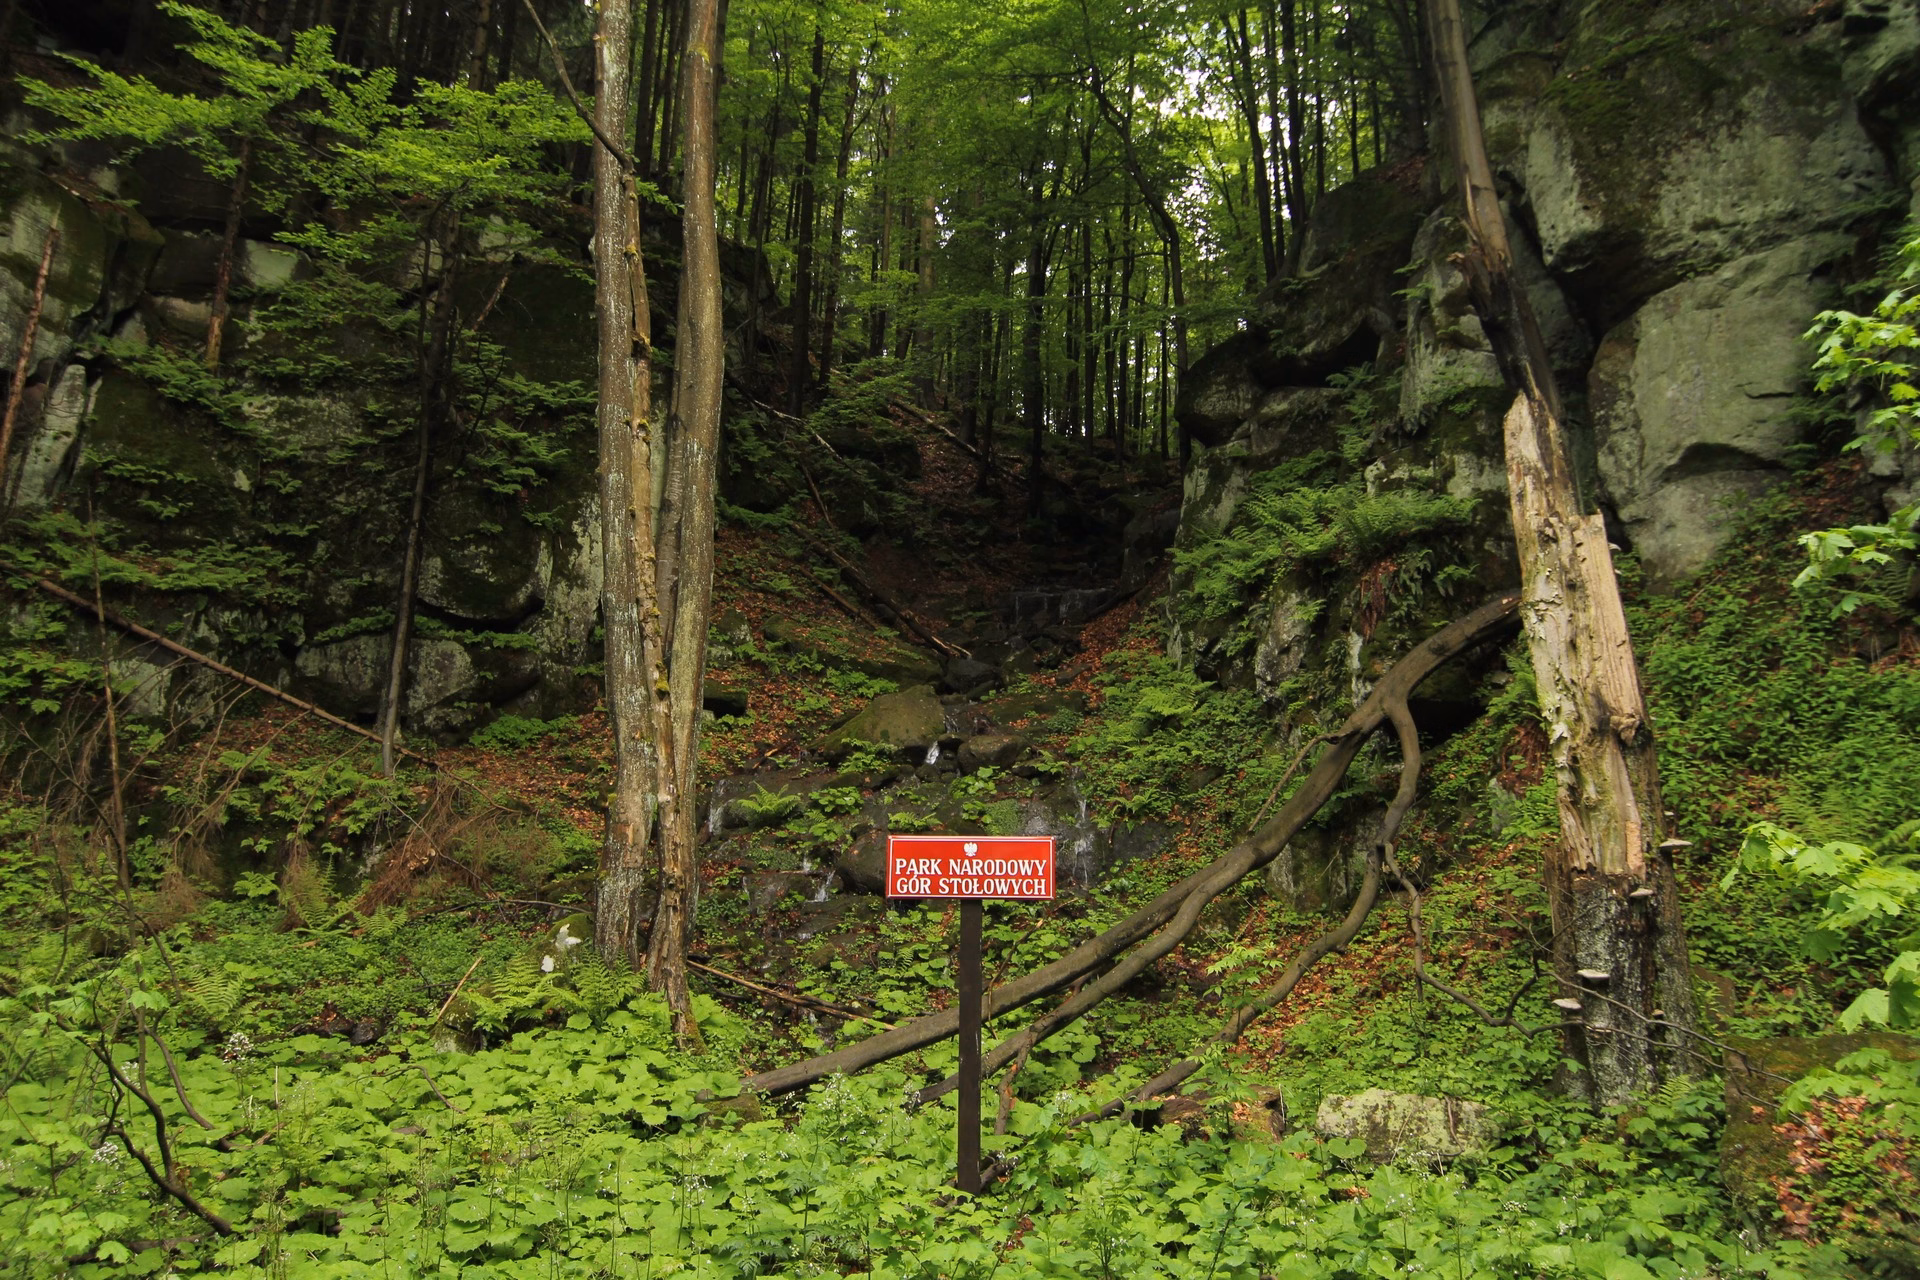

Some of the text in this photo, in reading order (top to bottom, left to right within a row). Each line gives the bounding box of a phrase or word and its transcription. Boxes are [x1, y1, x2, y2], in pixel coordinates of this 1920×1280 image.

[895, 858, 1047, 876] PARK NARODOWY
[896, 875, 1046, 895] GÓR STOŁOWYCH
